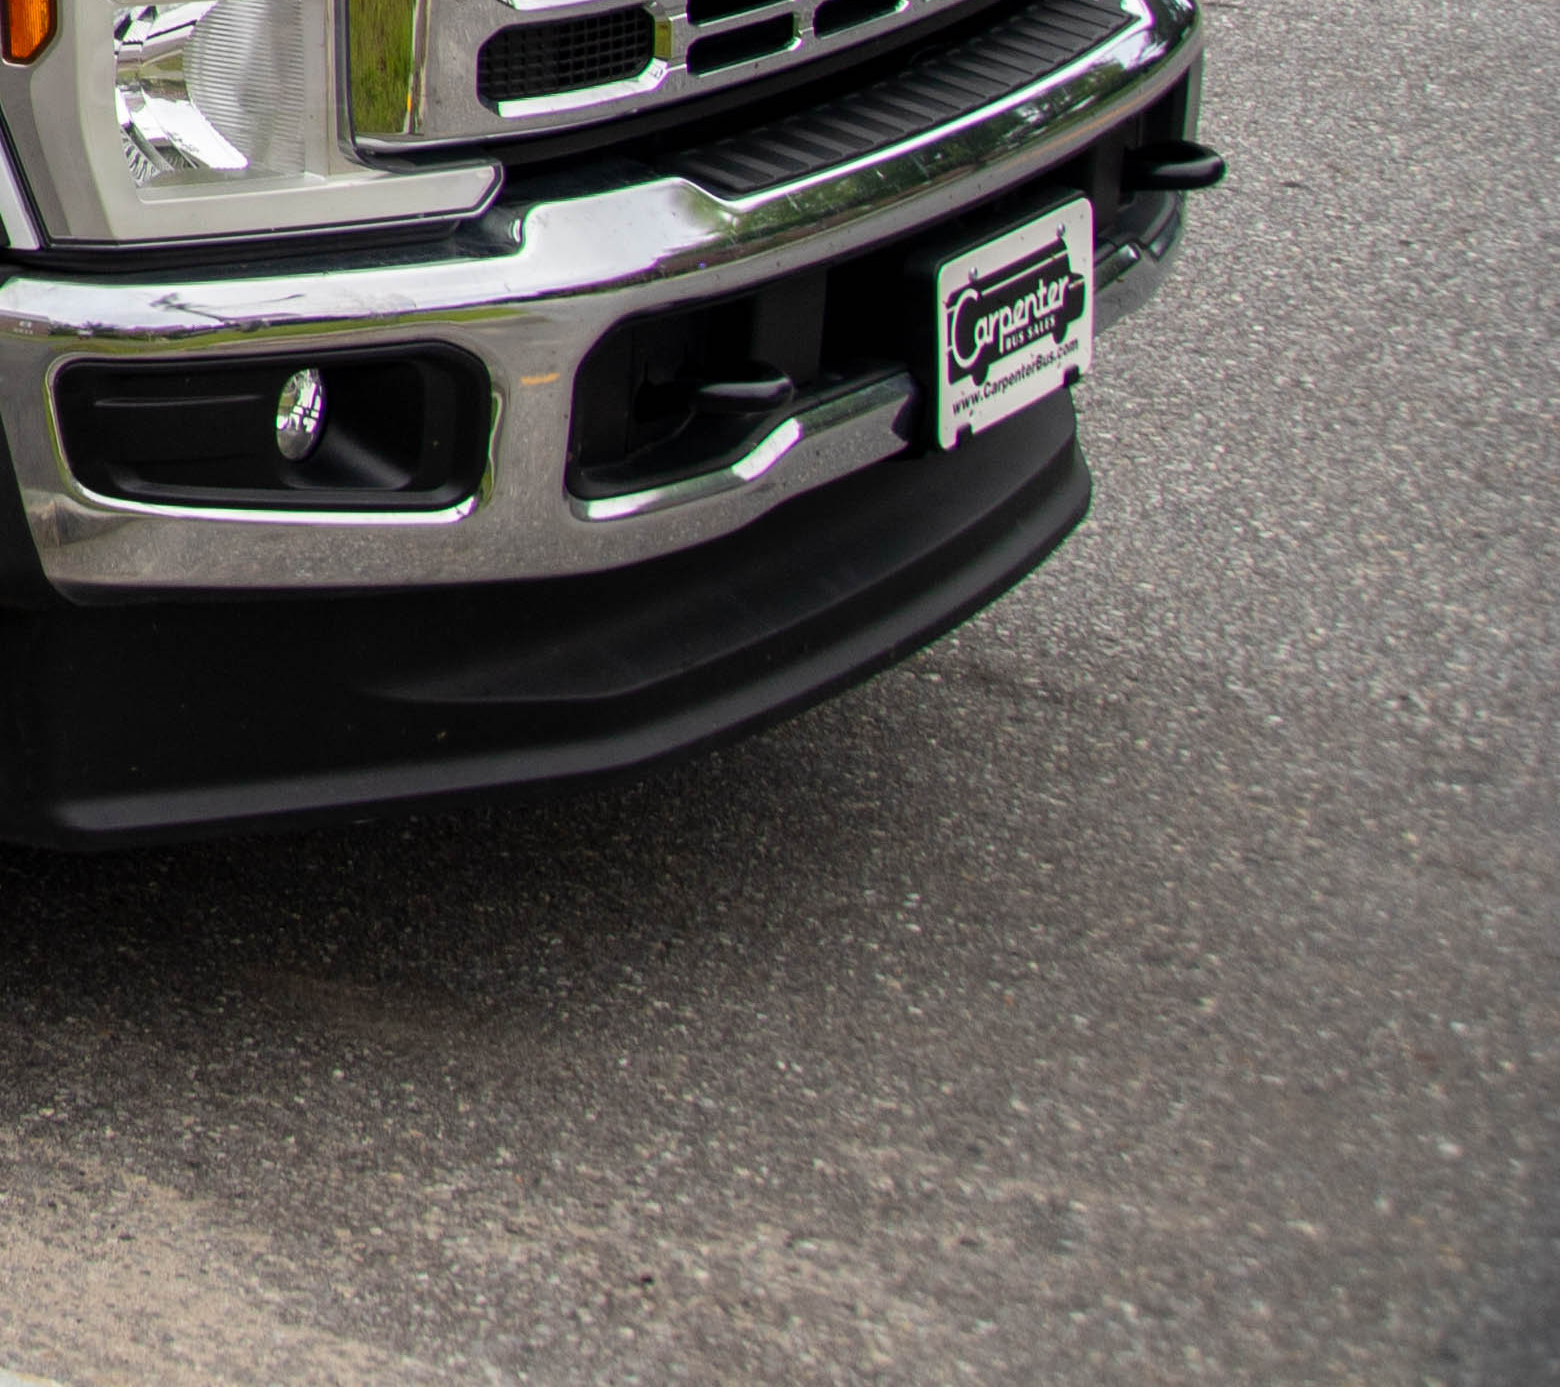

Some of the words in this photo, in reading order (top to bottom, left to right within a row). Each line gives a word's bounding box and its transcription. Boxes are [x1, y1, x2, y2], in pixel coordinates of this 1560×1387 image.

[951, 275, 1070, 369] Carpenter
[1005, 331, 1025, 351] BUS
[1026, 314, 1056, 339] SALES
[952, 337, 1080, 416] www.CarpenterBus.com
